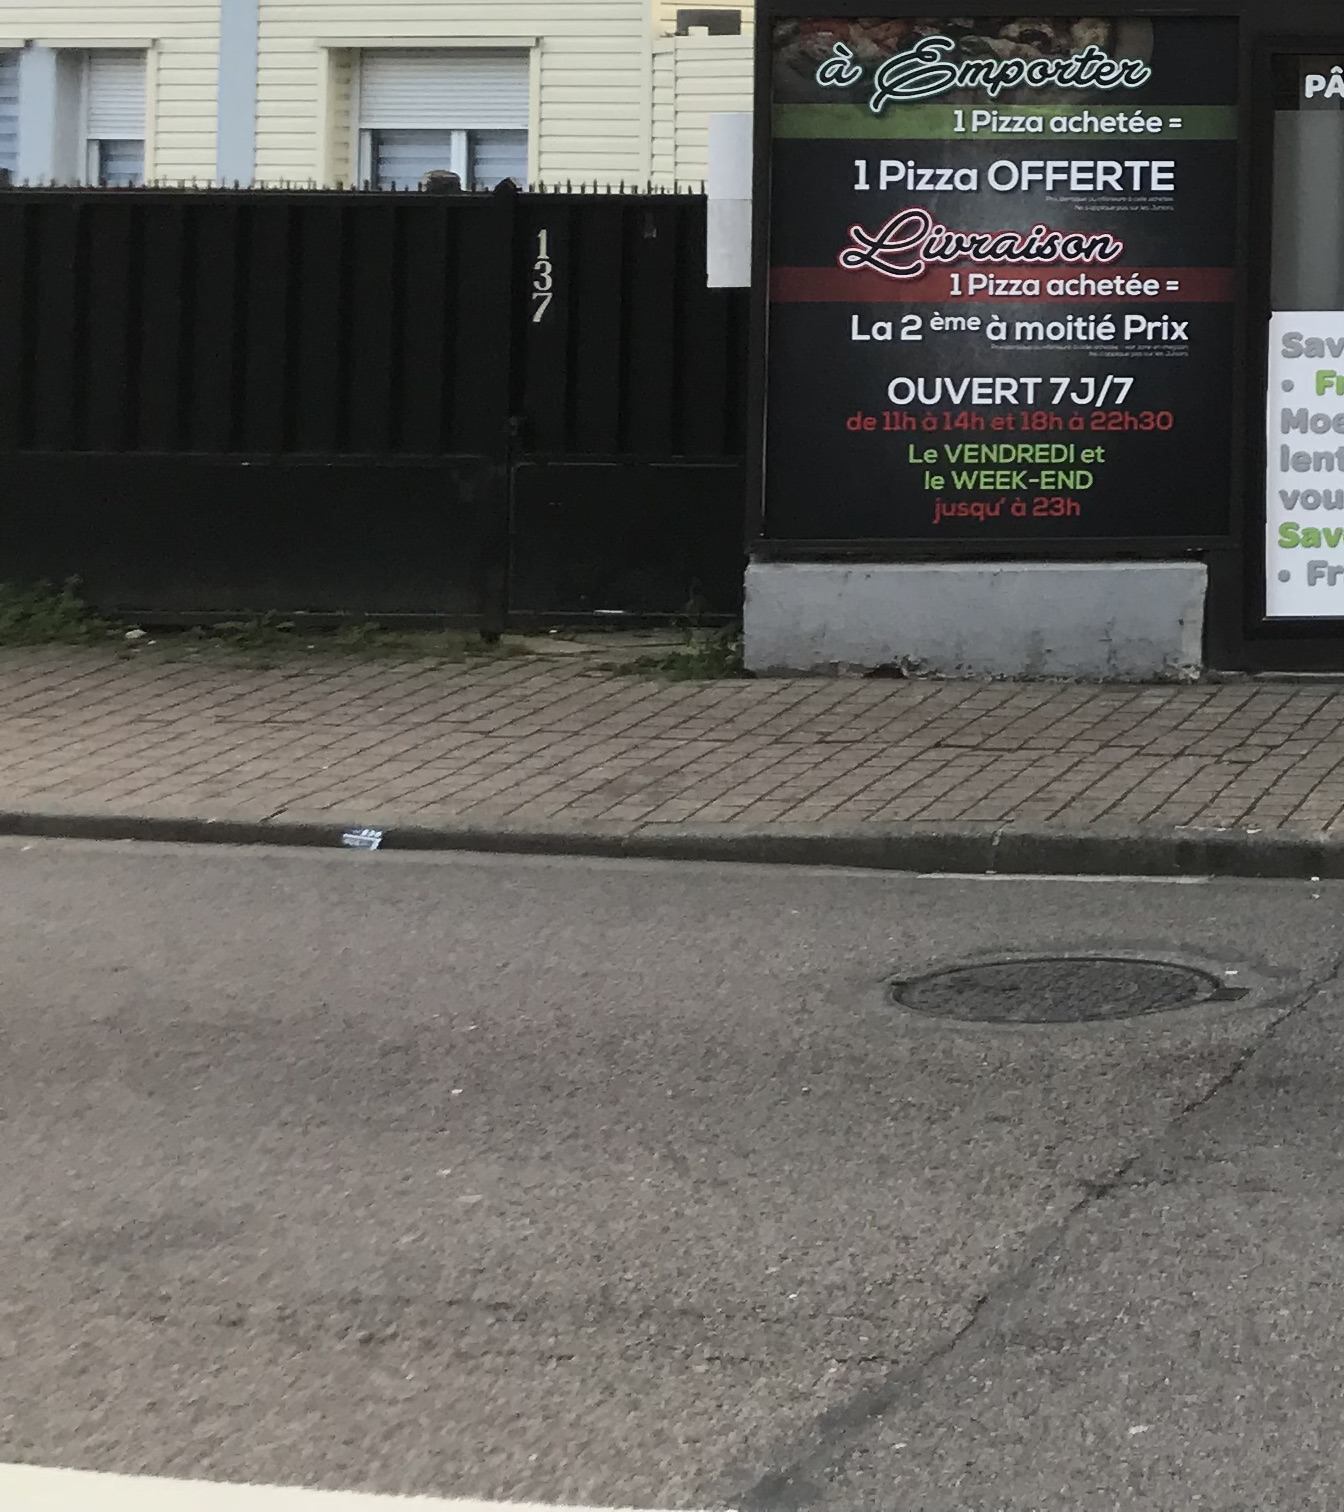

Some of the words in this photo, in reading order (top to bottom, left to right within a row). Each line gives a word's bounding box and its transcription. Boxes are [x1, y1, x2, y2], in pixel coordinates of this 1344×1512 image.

[816, 42, 861, 86] à
[869, 36, 1151, 112] Emporter
[953, 110, 965, 132] 1
[972, 110, 1043, 133] Pizza
[1049, 110, 1162, 133] achetée
[854, 160, 869, 190] 1
[879, 160, 978, 190] Pizza
[987, 160, 1175, 191] OFFERTE
[839, 208, 1124, 278] Livraison
[950, 273, 961, 295] 1
[968, 273, 1040, 296] Pizza
[1046, 273, 1160, 296] achetée
[851, 314, 892, 341] La
[900, 314, 923, 341] 2
[930, 311, 981, 332] ème
[986, 314, 1006, 341] à
[1015, 314, 1115, 341] moitié
[1124, 314, 1189, 341] Prix
[887, 376, 1042, 405] OUVERT
[1050, 374, 1134, 407] 7J/7
[846, 411, 876, 431] de
[883, 411, 916, 431] 11h
[922, 412, 938, 431] à
[943, 411, 984, 431] 14h
[990, 413, 1015, 431] et
[1021, 411, 1062, 431] 18h
[1068, 412, 1084, 431] à
[1090, 411, 1173, 431] 22h30
[908, 444, 938, 464] Le
[944, 444, 1074, 464] VENDREDI
[1080, 445, 1105, 464] et
[924, 470, 945, 490] le
[952, 471, 1093, 490] WEEK-END
[1011, 496, 1026, 516] à
[1032, 497, 1080, 516] 23h
